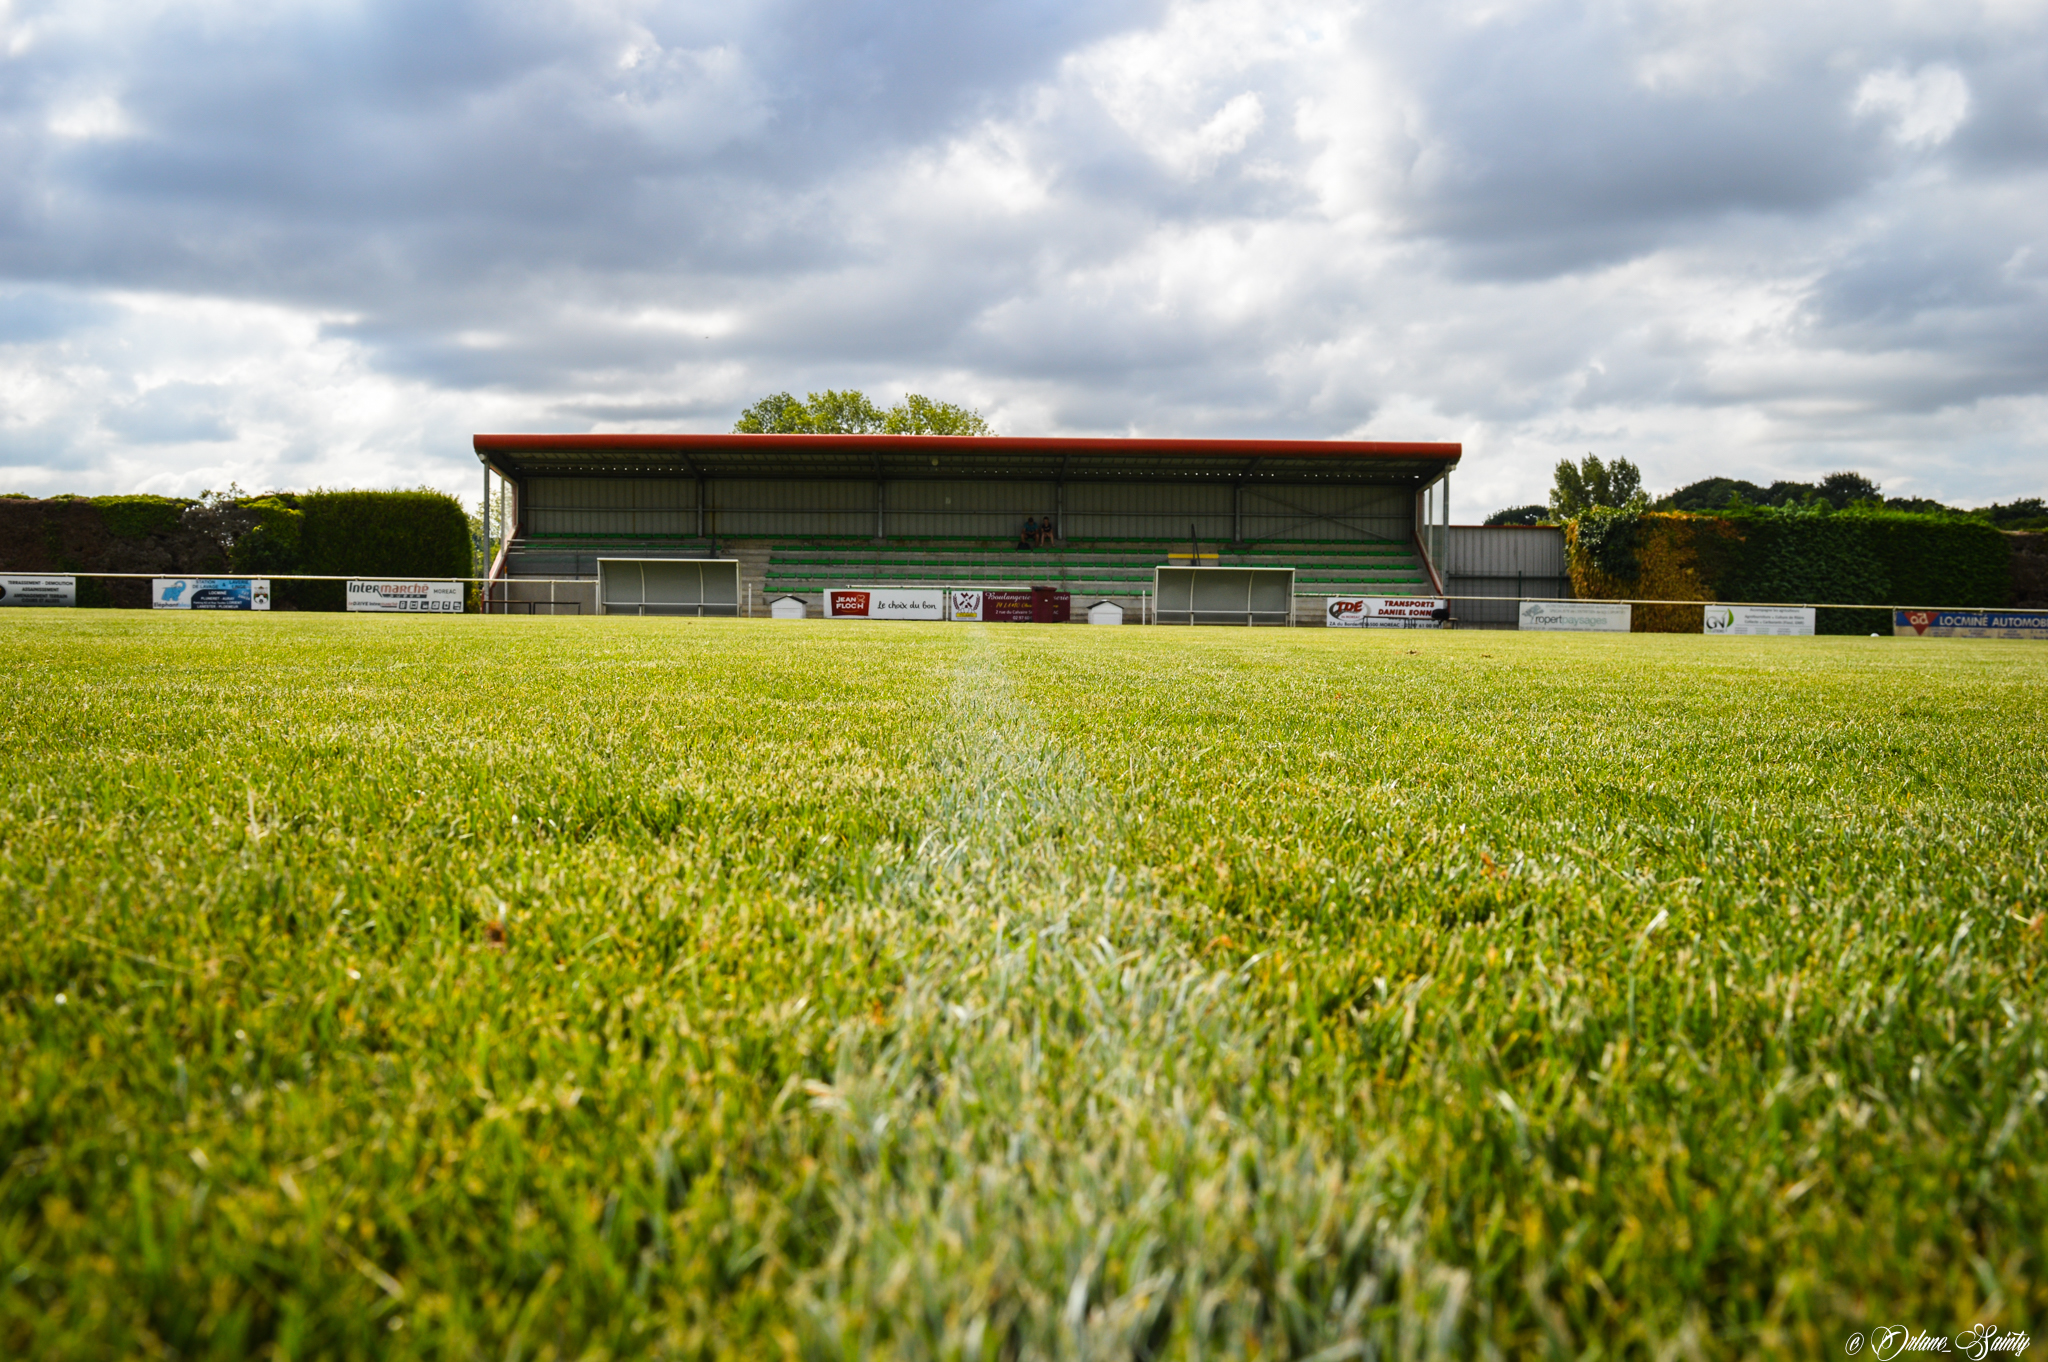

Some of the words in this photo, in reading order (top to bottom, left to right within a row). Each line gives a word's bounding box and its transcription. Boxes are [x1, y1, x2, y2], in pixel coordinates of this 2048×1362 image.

[985, 592, 1031, 602] Boulangerie
[878, 601, 886, 609] Le
[888, 601, 907, 609] choix
[922, 601, 937, 609] bon
[1336, 600, 1363, 613] TDE
[1940, 615, 1988, 626] LOCMINÉ
